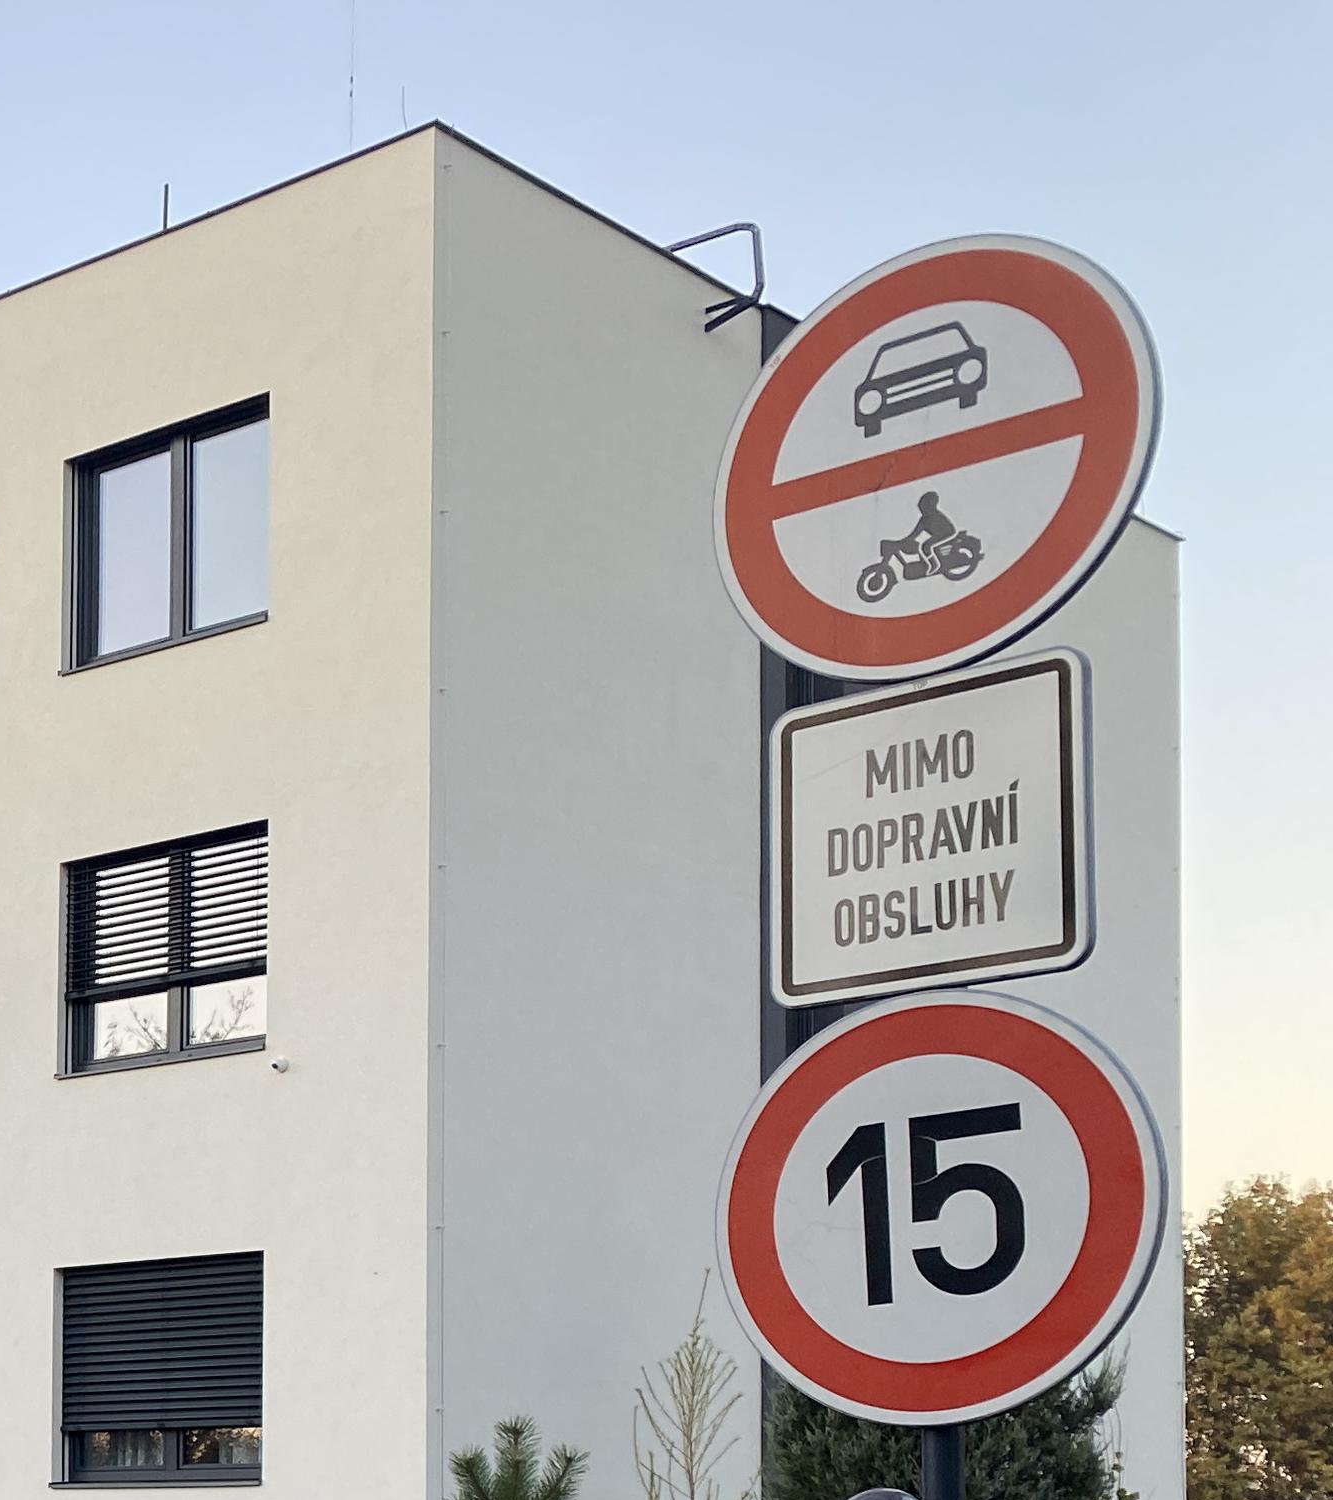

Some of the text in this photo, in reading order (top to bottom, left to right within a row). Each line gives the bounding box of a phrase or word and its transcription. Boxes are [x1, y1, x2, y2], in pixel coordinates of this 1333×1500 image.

[865, 729, 975, 799] MIMO
[828, 778, 1019, 877] DOPRAVNÍ
[834, 869, 1016, 947] OBSLUHY
[827, 1103, 1026, 1306] 15
